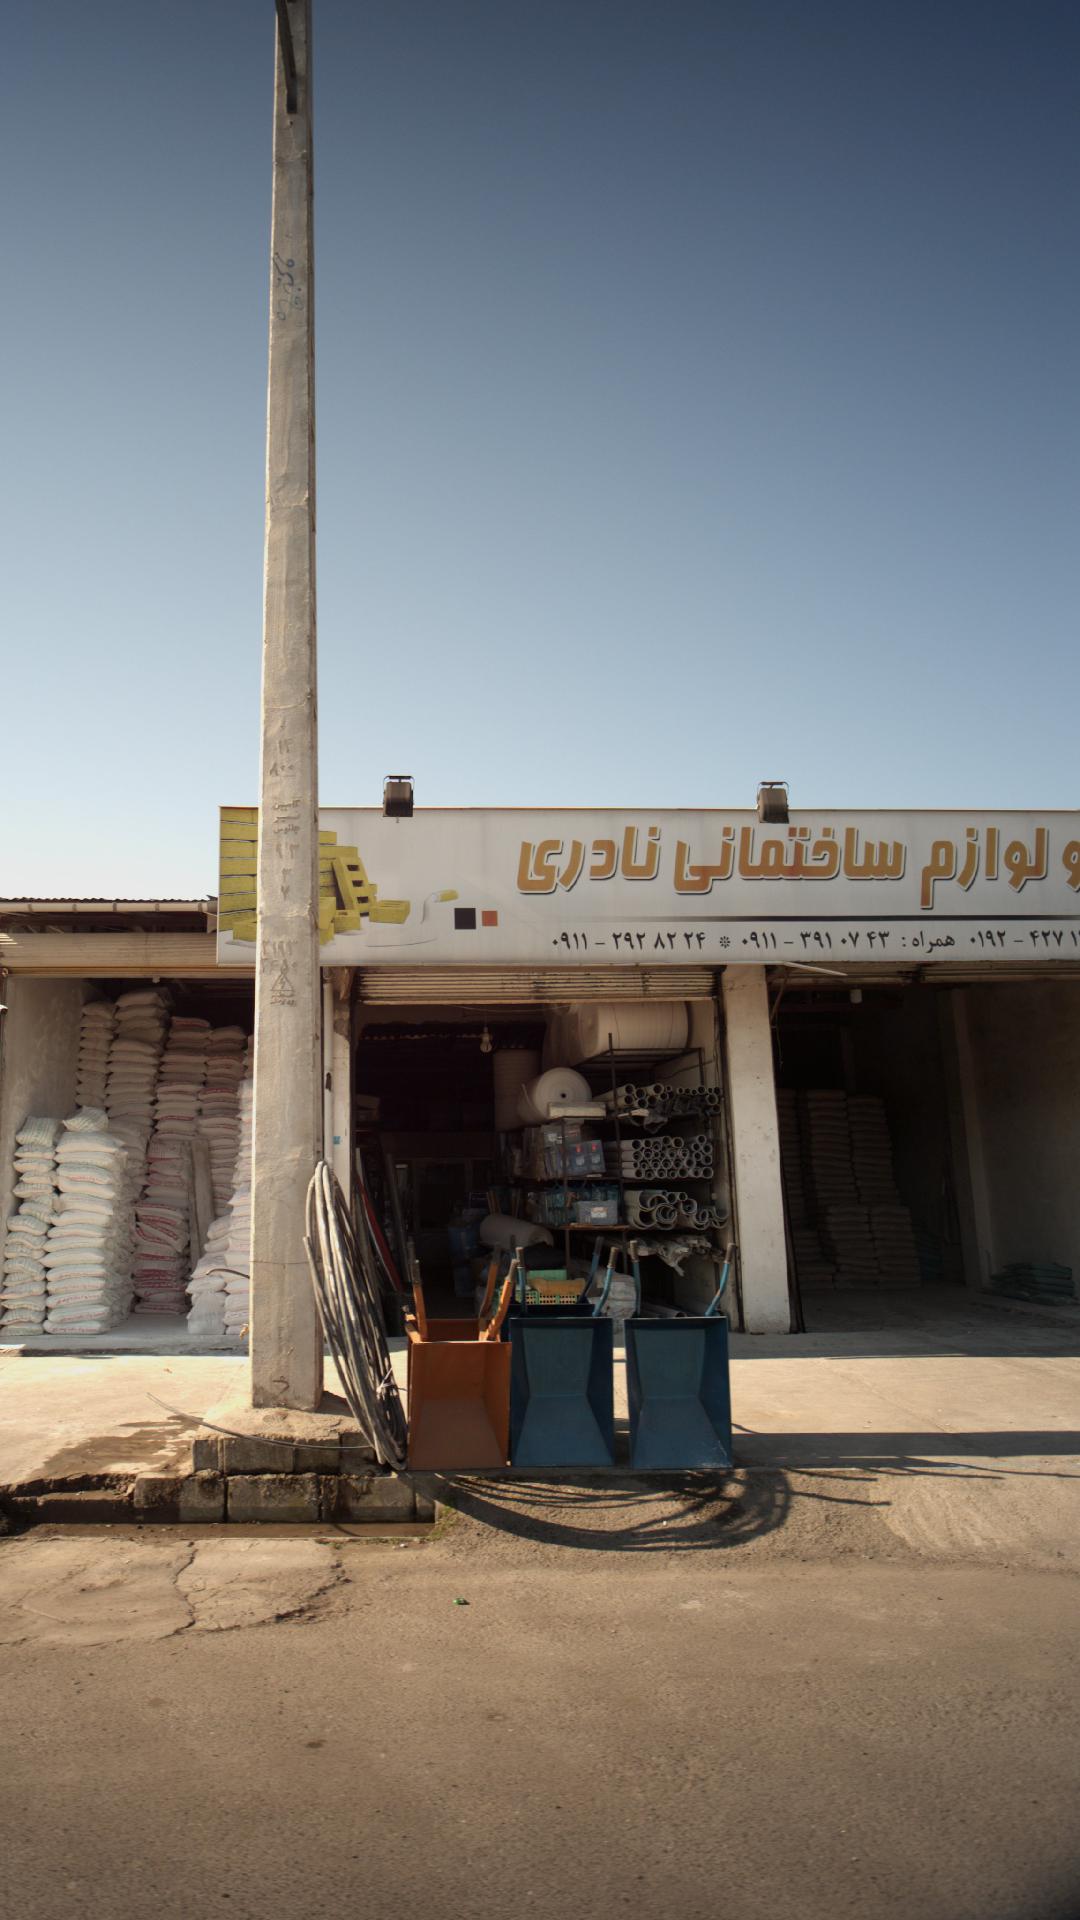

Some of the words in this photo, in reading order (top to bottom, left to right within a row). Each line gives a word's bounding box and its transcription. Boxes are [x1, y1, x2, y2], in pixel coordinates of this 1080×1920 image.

[516, 825, 660, 893] نادری
[673, 825, 904, 894] ساختمانی
[920, 826, 1048, 909] لوازم
[551, 931, 588, 951] ۰۹۱۱
[611, 931, 646, 951] ۲۹۲
[653, 931, 677, 951] ۸۲
[683, 931, 706, 951] ۲۴
[741, 931, 777, 950] ۰۹۱۱
[799, 930, 832, 949] ۳۹۱
[840, 930, 860, 949] ۰۷
[866, 930, 890, 949] ۴۳
[969, 929, 1006, 948] ۰۱۹۲
[1029, 929, 1064, 948] ۴۲۷
